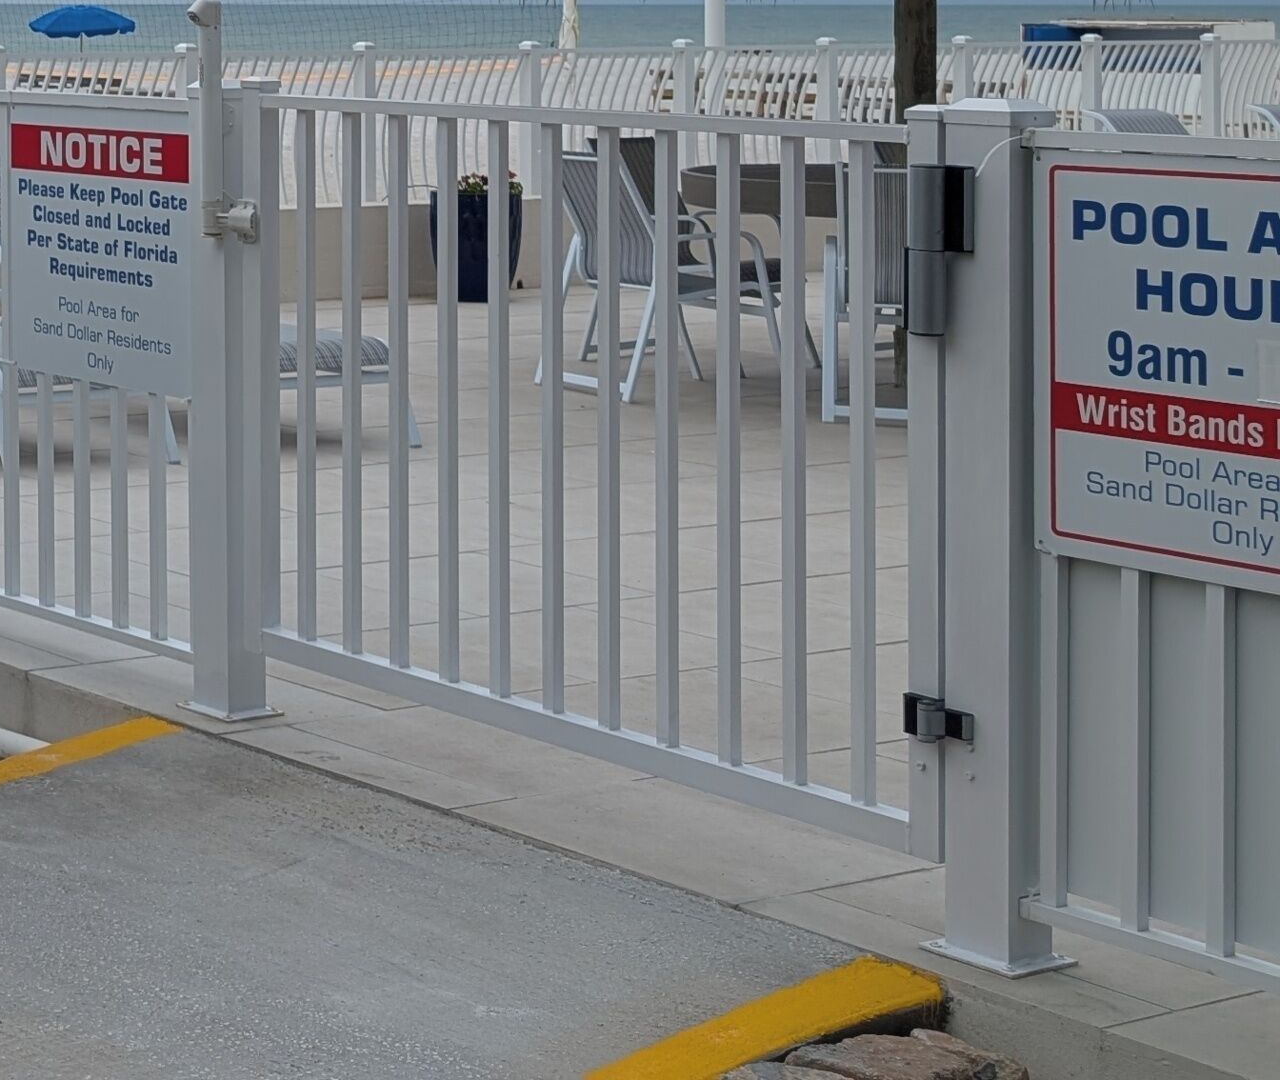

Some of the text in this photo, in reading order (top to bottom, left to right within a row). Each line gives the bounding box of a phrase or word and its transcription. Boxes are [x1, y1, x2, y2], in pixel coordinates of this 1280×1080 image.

[40, 130, 163, 175] NOTICE
[18, 178, 187, 211] Please Keep Pool Gate
[33, 204, 171, 236] Closed and Locked
[1073, 199, 1227, 251] POOL
[27, 229, 178, 264] Per State of Florida
[49, 257, 153, 288] Requirements
[58, 296, 139, 323] Pool Area for
[33, 317, 171, 355] Sand Dollar Residents
[87, 352, 114, 375] Only
[1107, 330, 1207, 386] 9am
[1076, 393, 1156, 433] Wrist
[1167, 404, 1264, 448] Bands
[1145, 450, 1280, 492] Pool Area
[1086, 471, 1153, 502] Sand
[1165, 483, 1248, 516] Dollar
[1212, 520, 1274, 556] Only
